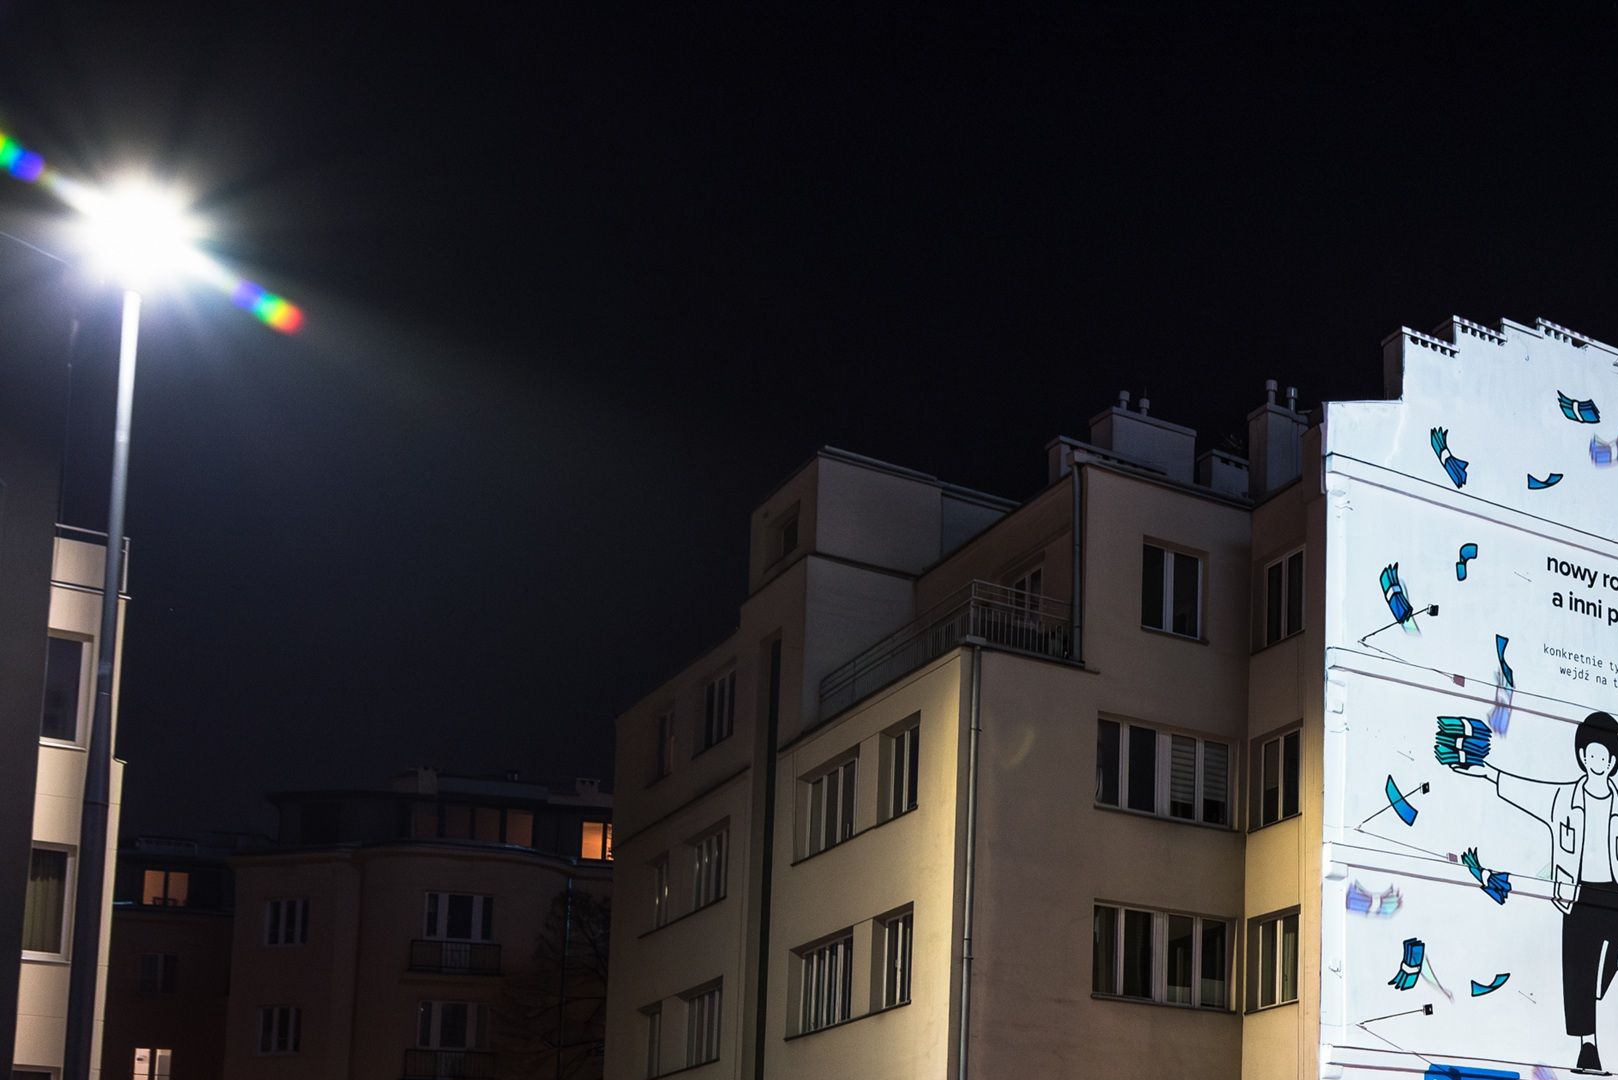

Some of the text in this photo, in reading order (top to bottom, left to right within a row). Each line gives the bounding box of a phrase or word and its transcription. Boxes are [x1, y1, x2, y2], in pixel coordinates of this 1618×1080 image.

[1547, 556, 1598, 588] nowy
[1552, 591, 1563, 608] a
[1569, 591, 1602, 619] inni
[1543, 643, 1603, 669] konkretnie
[1559, 666, 1590, 681] wejdź
[1596, 675, 1607, 685] na
